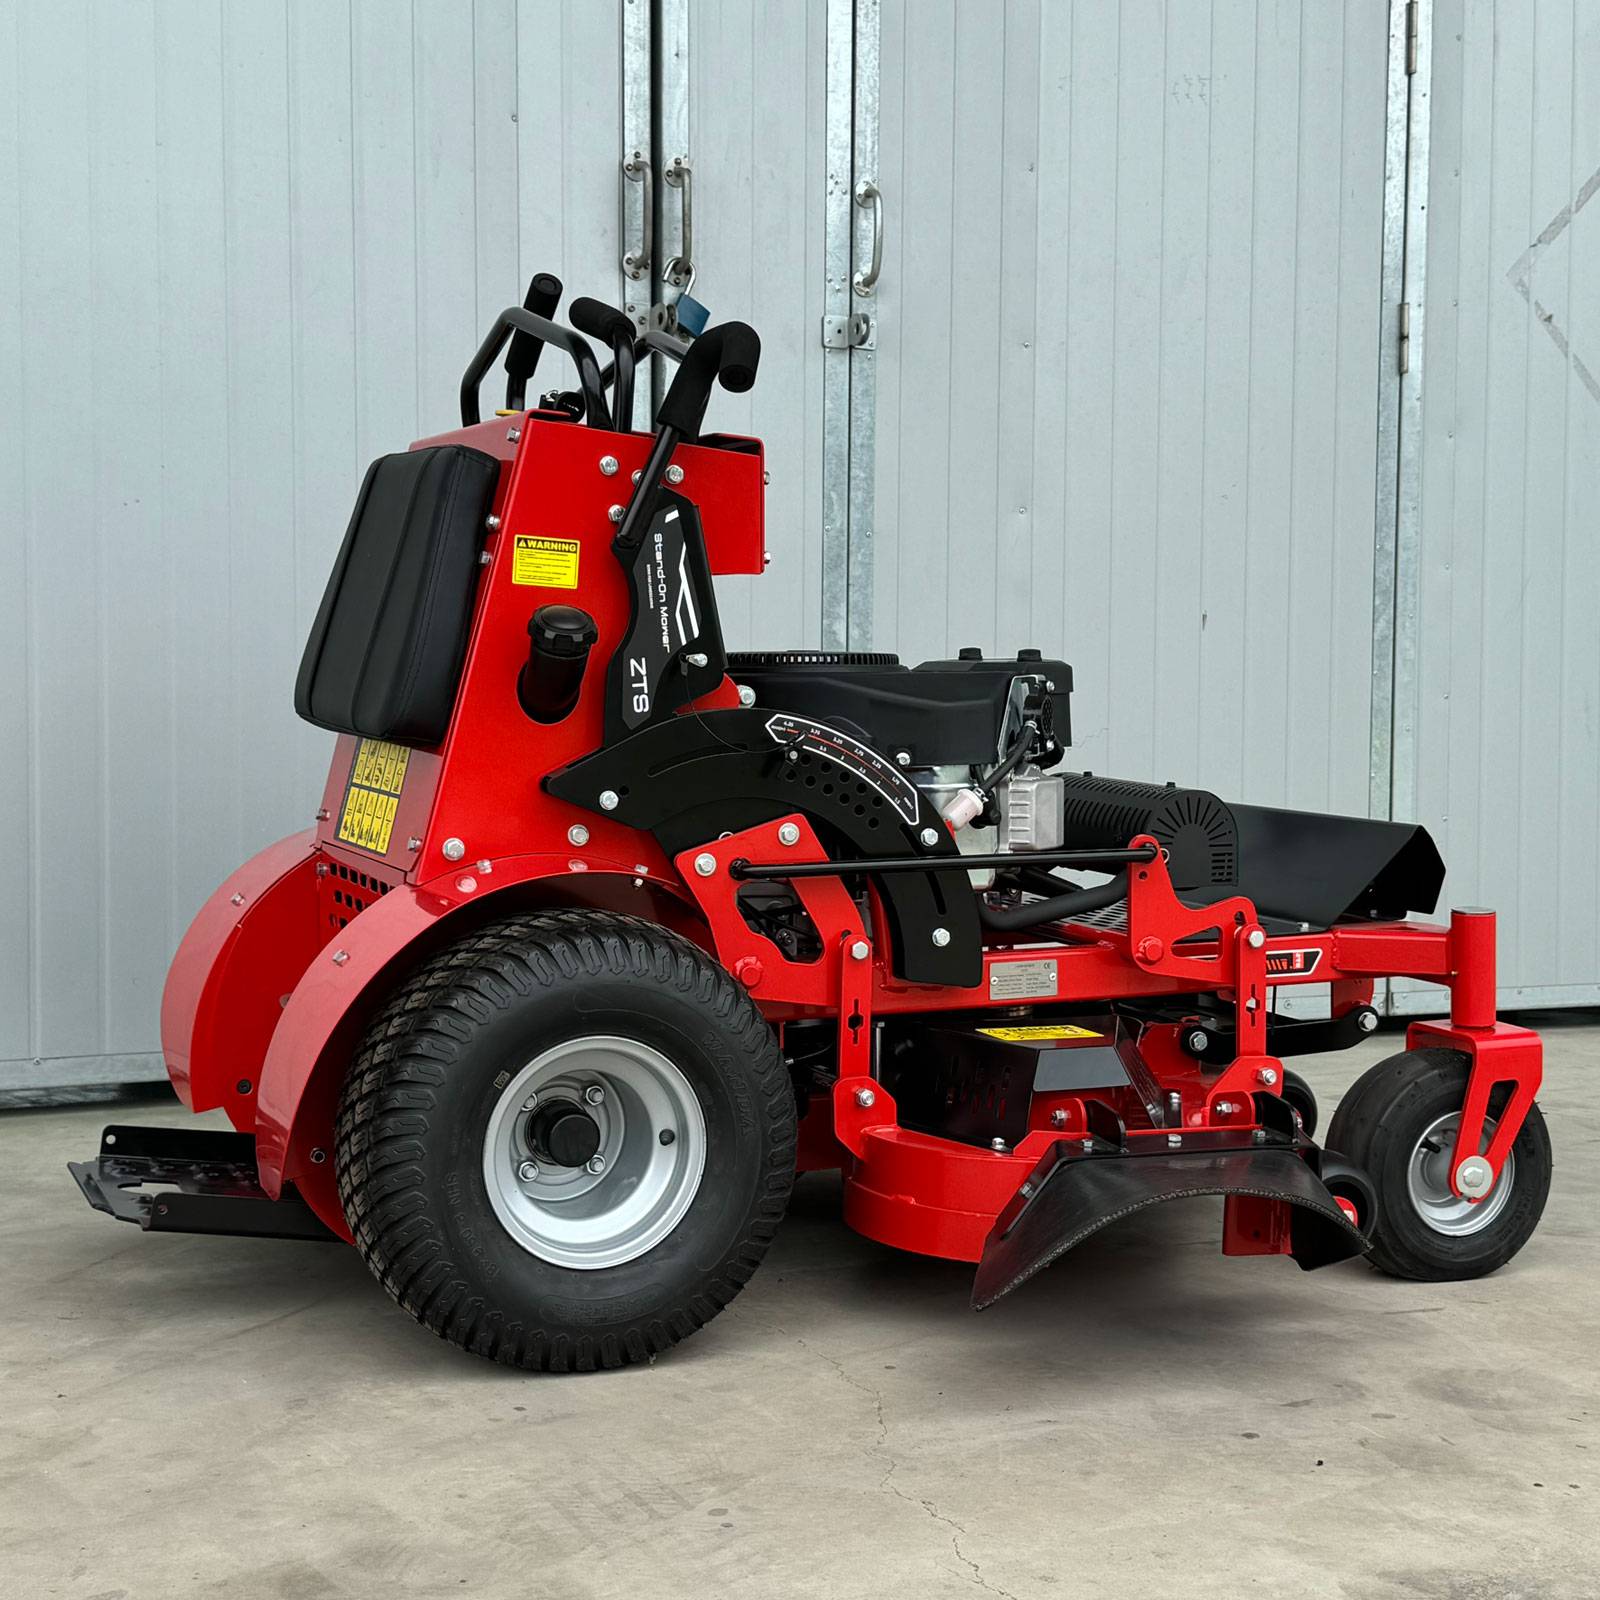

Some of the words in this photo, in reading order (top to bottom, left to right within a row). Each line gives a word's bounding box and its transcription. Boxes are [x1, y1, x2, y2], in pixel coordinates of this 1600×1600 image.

[527, 539, 577, 552] WARNING
[654, 533, 667, 602] Stand-On
[660, 606, 670, 653] Mower
[629, 657, 650, 713] ZTS
